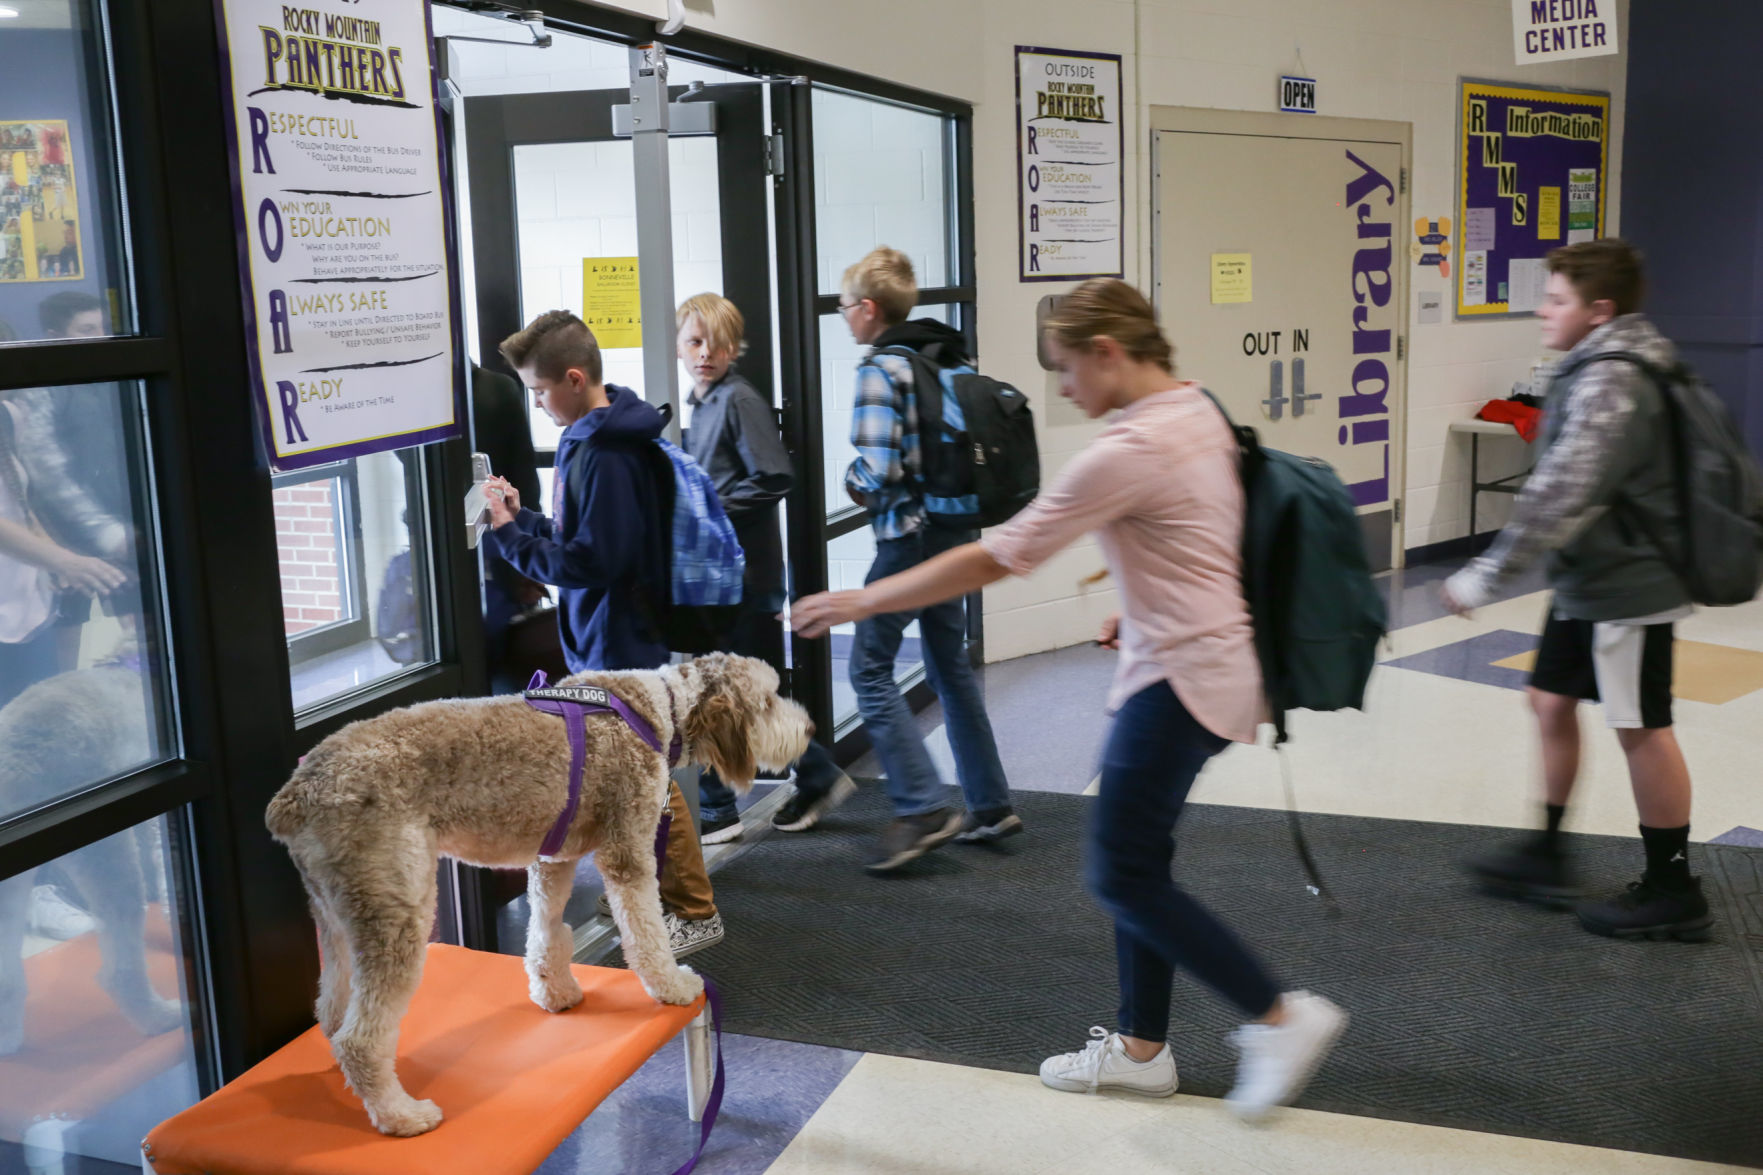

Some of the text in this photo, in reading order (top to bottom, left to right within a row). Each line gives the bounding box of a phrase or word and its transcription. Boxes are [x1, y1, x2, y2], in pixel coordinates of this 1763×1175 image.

[1531, 0, 1598, 24] MEDIA
[282, 5, 382, 45] ROCKY MOUNTAIN
[1525, 22, 1607, 54] CENTER
[258, 25, 406, 101] PANTHERS
[1045, 63, 1095, 79] OUTSIDE
[1048, 81, 1065, 93] ROCKY
[1283, 81, 1315, 109] OPEN
[1036, 90, 1104, 120] PANTHERS
[1508, 108, 1601, 140] Information
[296, 140, 421, 157] FOLLOW DIRECTIONS OF THE BUS DRIVER
[312, 152, 372, 164] FOLLOW BUS RULES
[328, 164, 417, 175] USE APPROPRIATE LANGUAGE
[1042, 173, 1092, 183] EDUCATION
[1569, 184, 1596, 193] COLLEGE
[1572, 193, 1591, 201] FAIR
[302, 202, 332, 215] YOUR
[1069, 207, 1088, 216] SAFE
[290, 217, 391, 237] EDUCATION
[335, 243, 349, 251] OUR
[312, 254, 328, 262] WHY
[344, 254, 357, 262] YOU
[370, 254, 383, 262] THE
[313, 266, 338, 275] BEHAVE
[340, 265, 388, 274] APPROPRIATELY
[351, 290, 388, 311] SAFE
[313, 320, 328, 328] STAY
[339, 318, 353, 327] LINE
[375, 315, 403, 324] DIRECTED
[1338, 149, 1395, 507] Library
[329, 330, 353, 338] REPORT
[346, 339, 361, 347] KEEP
[362, 336, 392, 346] YOURSELF
[1243, 329, 1309, 356] OUT IN
[325, 405, 333, 413] BE
[334, 401, 355, 410] AWARE
[365, 398, 377, 406] THE
[377, 396, 395, 405] TIME
[529, 688, 605, 702] THERAPY DOG
